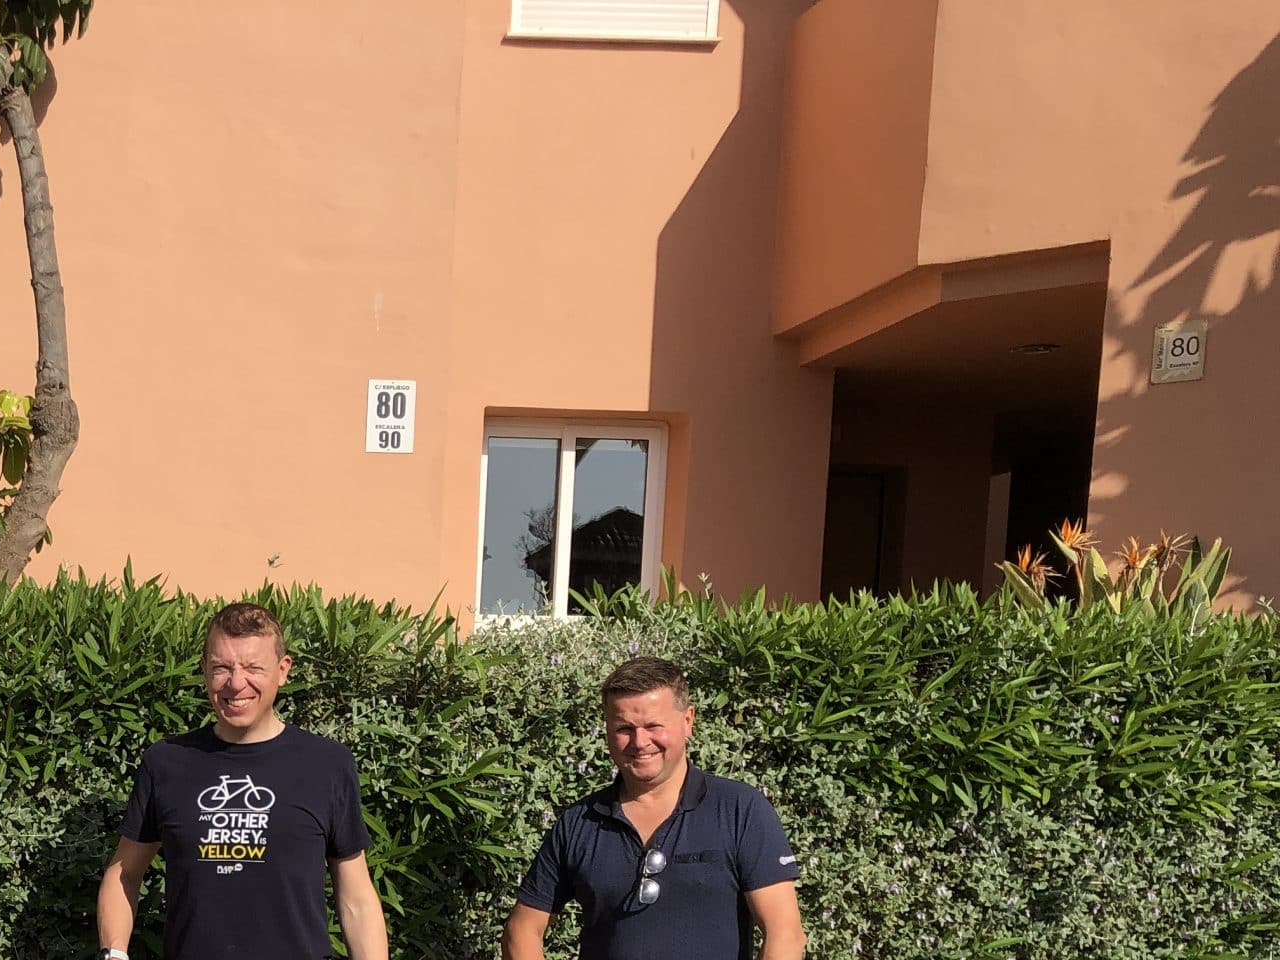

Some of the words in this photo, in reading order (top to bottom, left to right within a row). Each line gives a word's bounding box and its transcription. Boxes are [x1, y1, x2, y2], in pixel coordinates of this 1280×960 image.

[1171, 336, 1200, 357] 80
[376, 391, 407, 419] 80
[378, 430, 401, 449] 90
[212, 813, 269, 828] OTHER
[200, 829, 263, 845] JERSEY
[260, 837, 267, 845] IS
[198, 845, 267, 859] YELLOW
